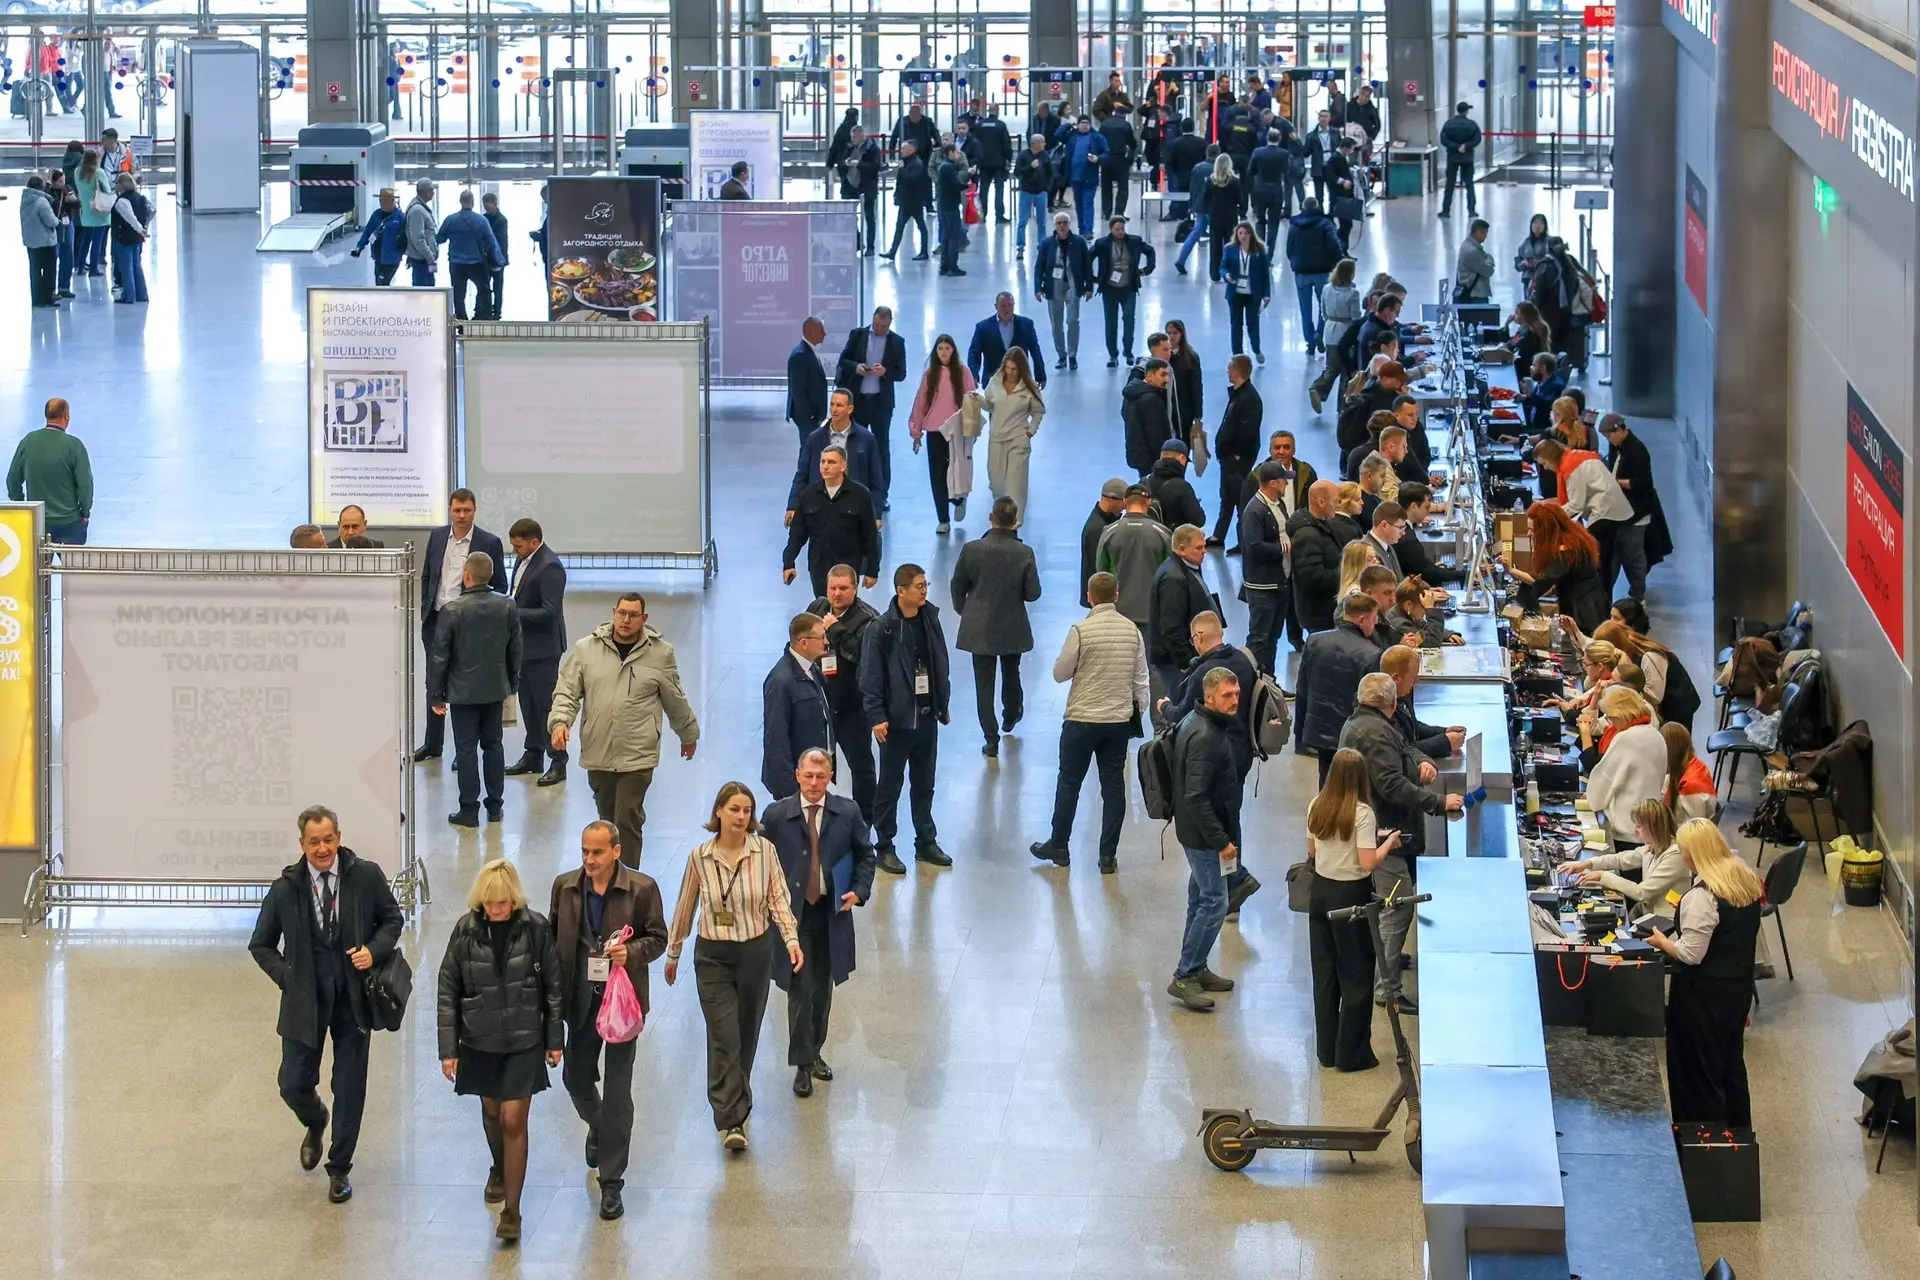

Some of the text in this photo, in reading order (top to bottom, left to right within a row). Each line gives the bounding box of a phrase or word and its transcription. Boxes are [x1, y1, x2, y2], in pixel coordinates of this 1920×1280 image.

[1773, 41, 1839, 139] РЕГИСТРАЦИЯ
[1852, 97, 1916, 202] REGISTRA
[322, 302, 368, 313] ДИЗАЙН
[322, 316, 432, 327] И ПРОЕКТИРОВАНИЕ
[323, 328, 432, 338] ВЫСТАВОЧНЫХ ЭКСПОЗИЦИЙ
[332, 347, 397, 356] BUILDEXPO
[1853, 473, 1895, 557] РЕГИСТРАЦИЯ
